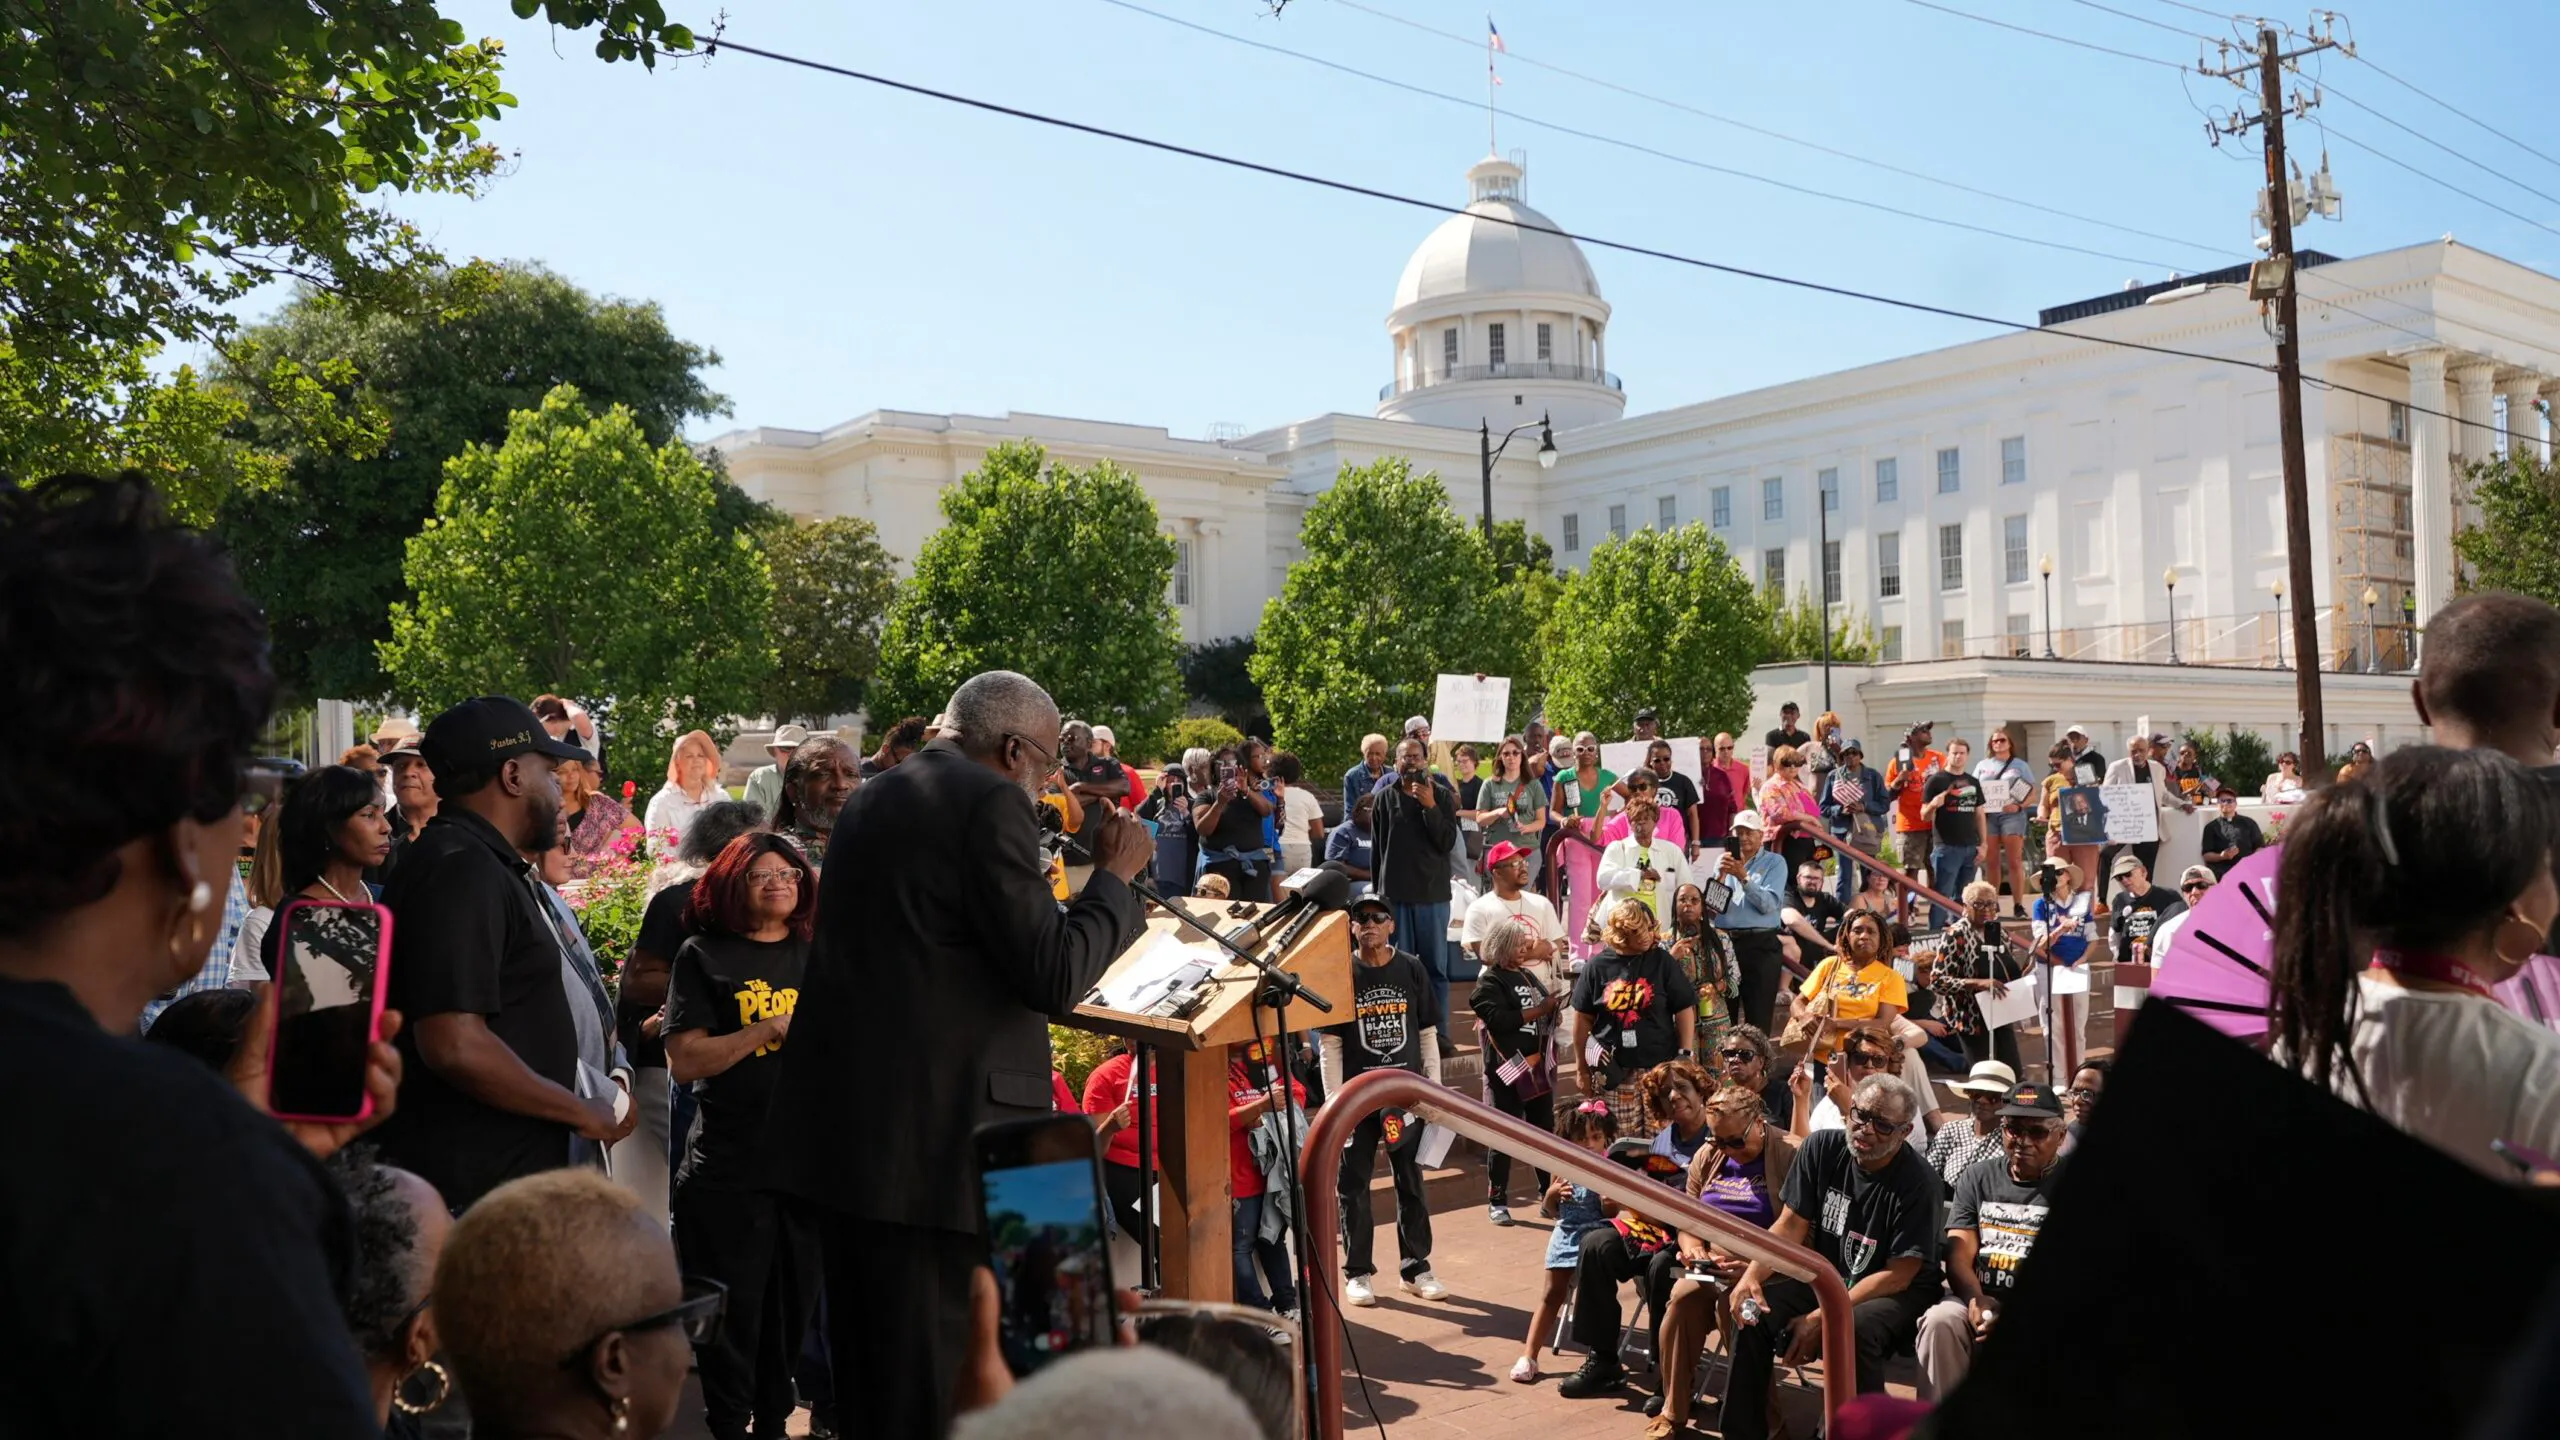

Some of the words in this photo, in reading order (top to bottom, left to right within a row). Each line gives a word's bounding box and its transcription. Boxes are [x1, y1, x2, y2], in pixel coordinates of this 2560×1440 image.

[490, 738, 517, 750] Pastor
[1358, 990, 1403, 1003] BUILDING
[1356, 1000, 1376, 1008] BLACK
[1357, 1003, 1408, 1017] POWER
[1366, 1020, 1401, 1031] BLACK
[1367, 1028, 1402, 1036] RADICAL
[1988, 1253, 2018, 1271] NOT
